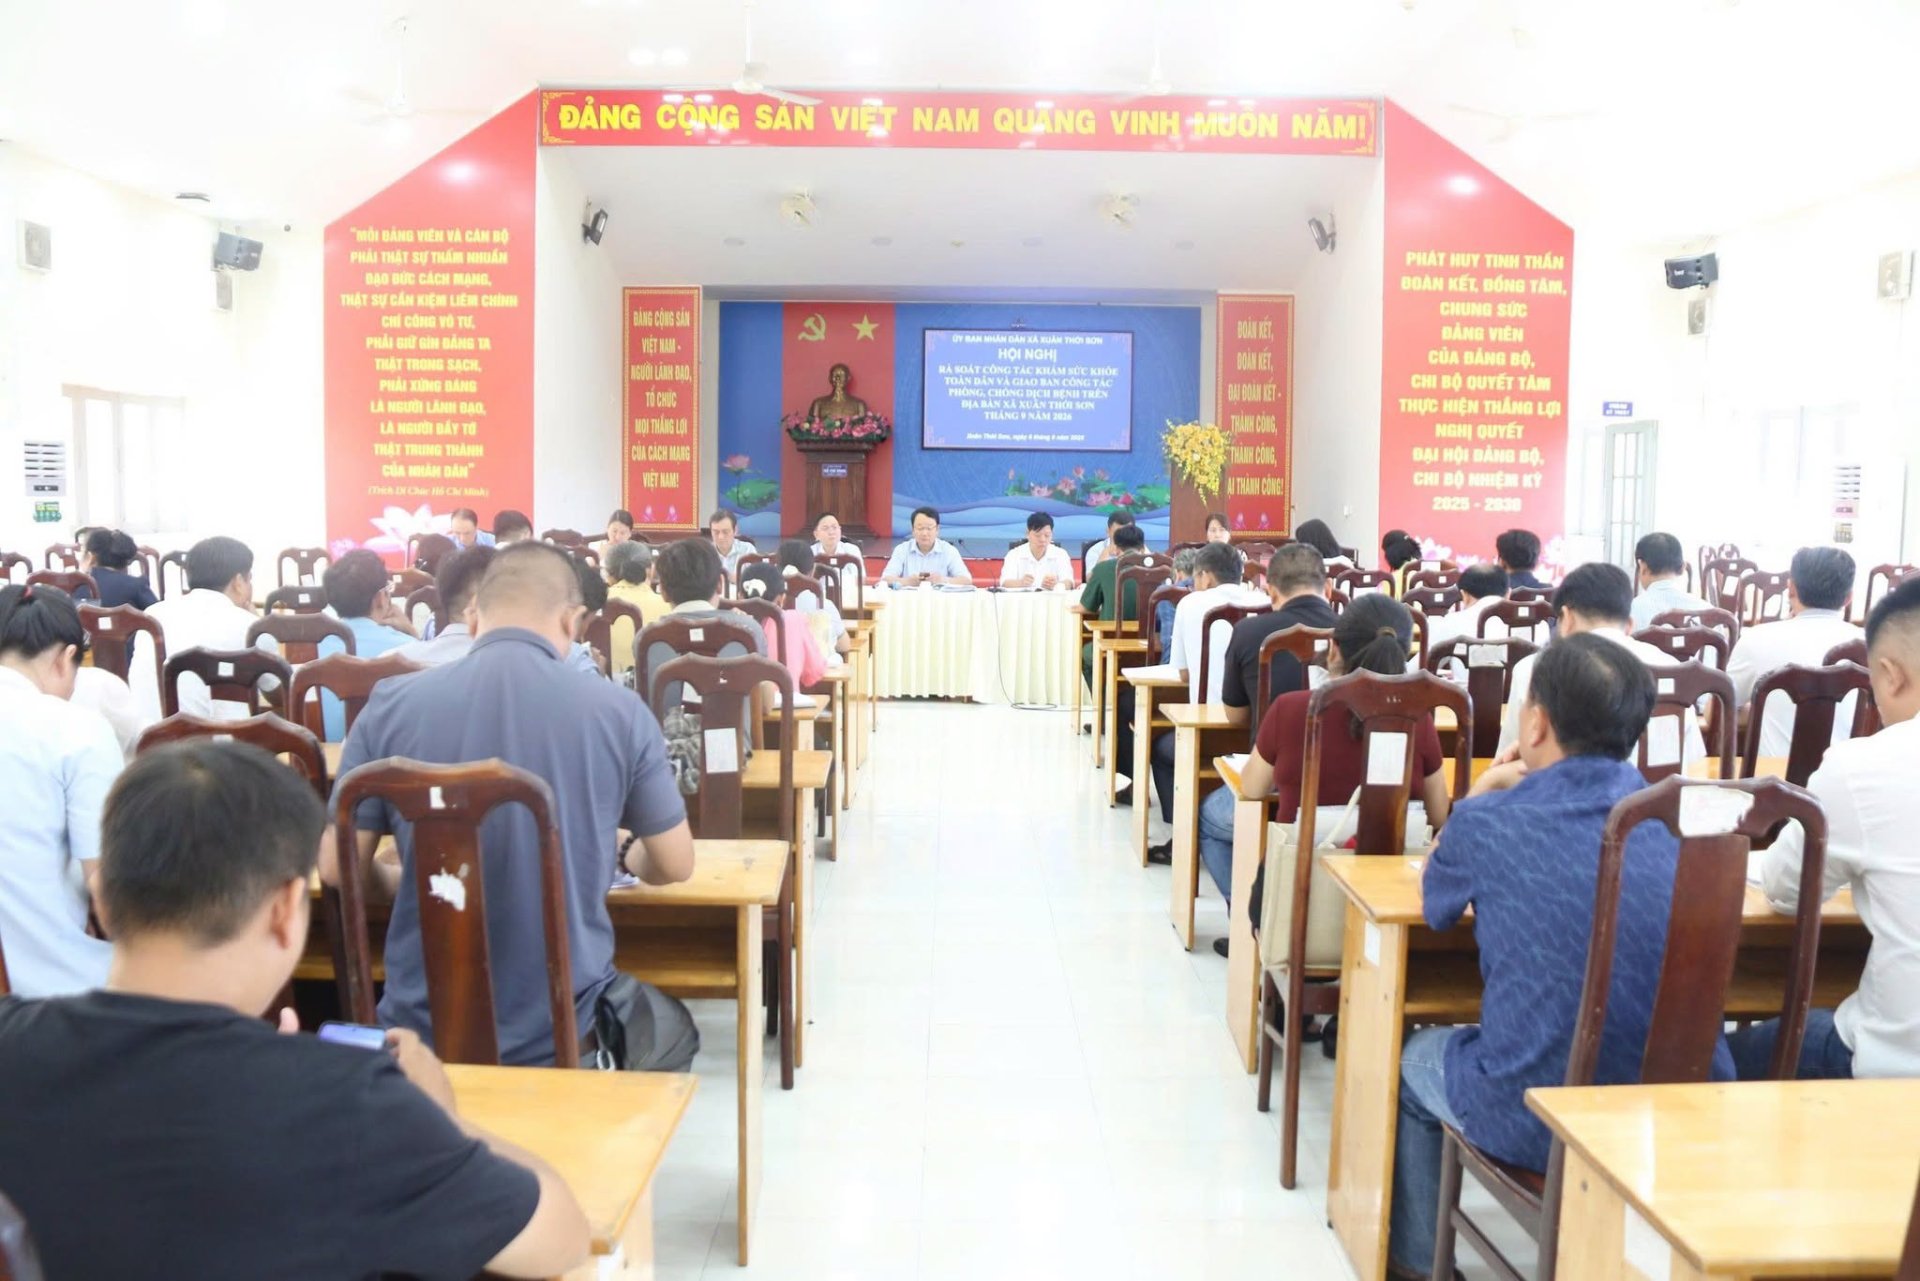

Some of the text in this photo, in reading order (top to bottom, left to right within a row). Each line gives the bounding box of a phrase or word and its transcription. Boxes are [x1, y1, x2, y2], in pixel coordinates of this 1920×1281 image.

[560, 96, 1366, 140] ĐẢNG CỘNG SẢN VIỆT NAM QUANG VINH MUÔN NĂM!
[446, 227, 462, 242] VÀ
[1406, 250, 1446, 266] PHÁT
[1450, 253, 1480, 268] HUY
[1484, 253, 1520, 268] TINH
[1440, 300, 1528, 318] CHUNG SỨC
[1489, 324, 1524, 342] VIÊN
[478, 337, 492, 350] TA
[660, 337, 676, 354] NAM
[998, 347, 1057, 363] HỘI NGHỊ
[1428, 346, 1459, 365] CỦA
[405, 358, 444, 371] TRONG
[1411, 374, 1437, 389] CHI
[1442, 372, 1462, 392] BỘ
[1399, 398, 1438, 416] THỰC
[1443, 396, 1479, 416] HIỆN
[1537, 400, 1561, 418] LỢI
[1435, 424, 1472, 441] NGHỊ
[404, 444, 442, 456] TRUNG
[1413, 472, 1440, 486] CHI
